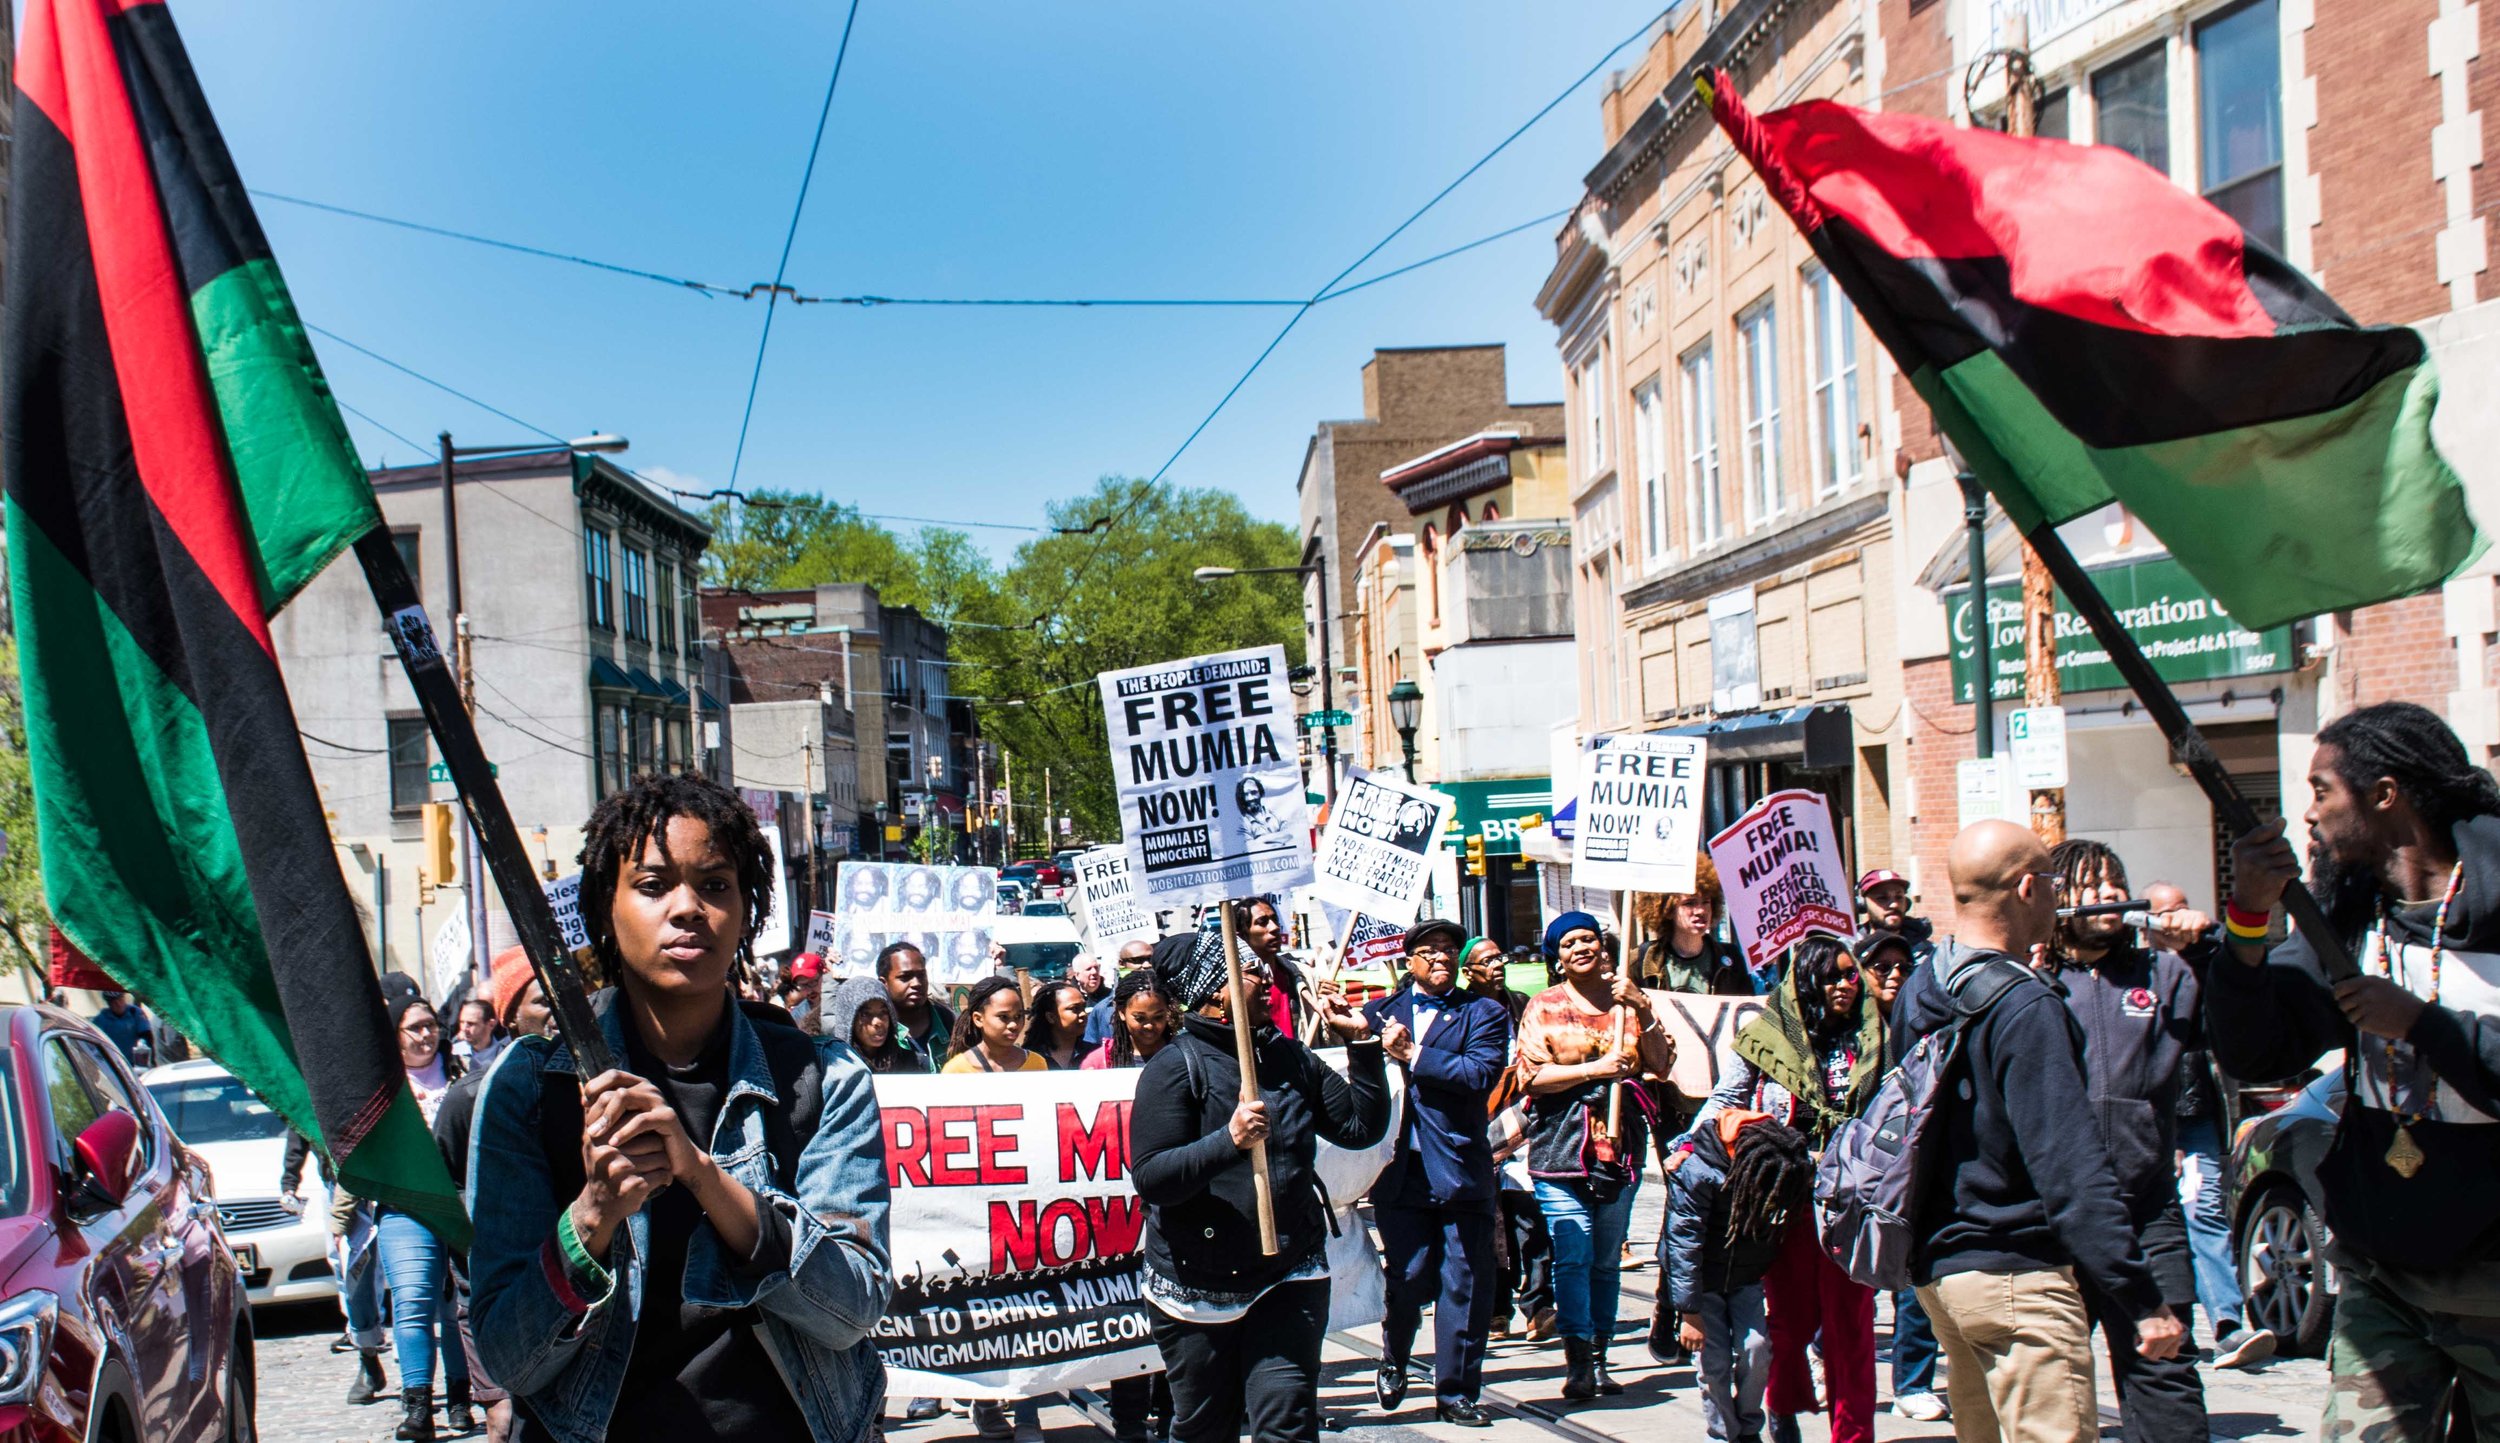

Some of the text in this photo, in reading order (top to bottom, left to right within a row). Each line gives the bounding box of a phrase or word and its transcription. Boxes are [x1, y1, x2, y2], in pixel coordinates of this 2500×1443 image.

[1120, 659, 1267, 695] THE PEOPLE DEMAND:
[1124, 679, 1273, 736] FREE
[2015, 715, 2027, 737] 2
[1130, 723, 1281, 785] MUMIA
[1594, 753, 1691, 779] FREE
[1137, 784, 1220, 829] NOW!
[1351, 780, 1404, 805] FREE
[1590, 781, 1688, 809] MUMIA
[1145, 828, 1207, 851] MUMIA IS
[1340, 811, 1397, 841] NOW!
[1589, 813, 1640, 835] NOW!
[1745, 806, 1795, 853] FREE
[1147, 844, 1208, 866] INNOCENT!
[1335, 835, 1356, 850] END
[1391, 855, 1421, 873] MASS
[1738, 831, 1819, 889] MUMIA!
[546, 883, 579, 902] elea
[1087, 877, 1132, 902] MUMI
[1148, 856, 1299, 894] MOBILIZATION4MUMIA.COM
[1760, 861, 1819, 905] FREE ALL
[880, 1104, 1028, 1188] REE
[966, 1289, 1058, 1331] BRING
